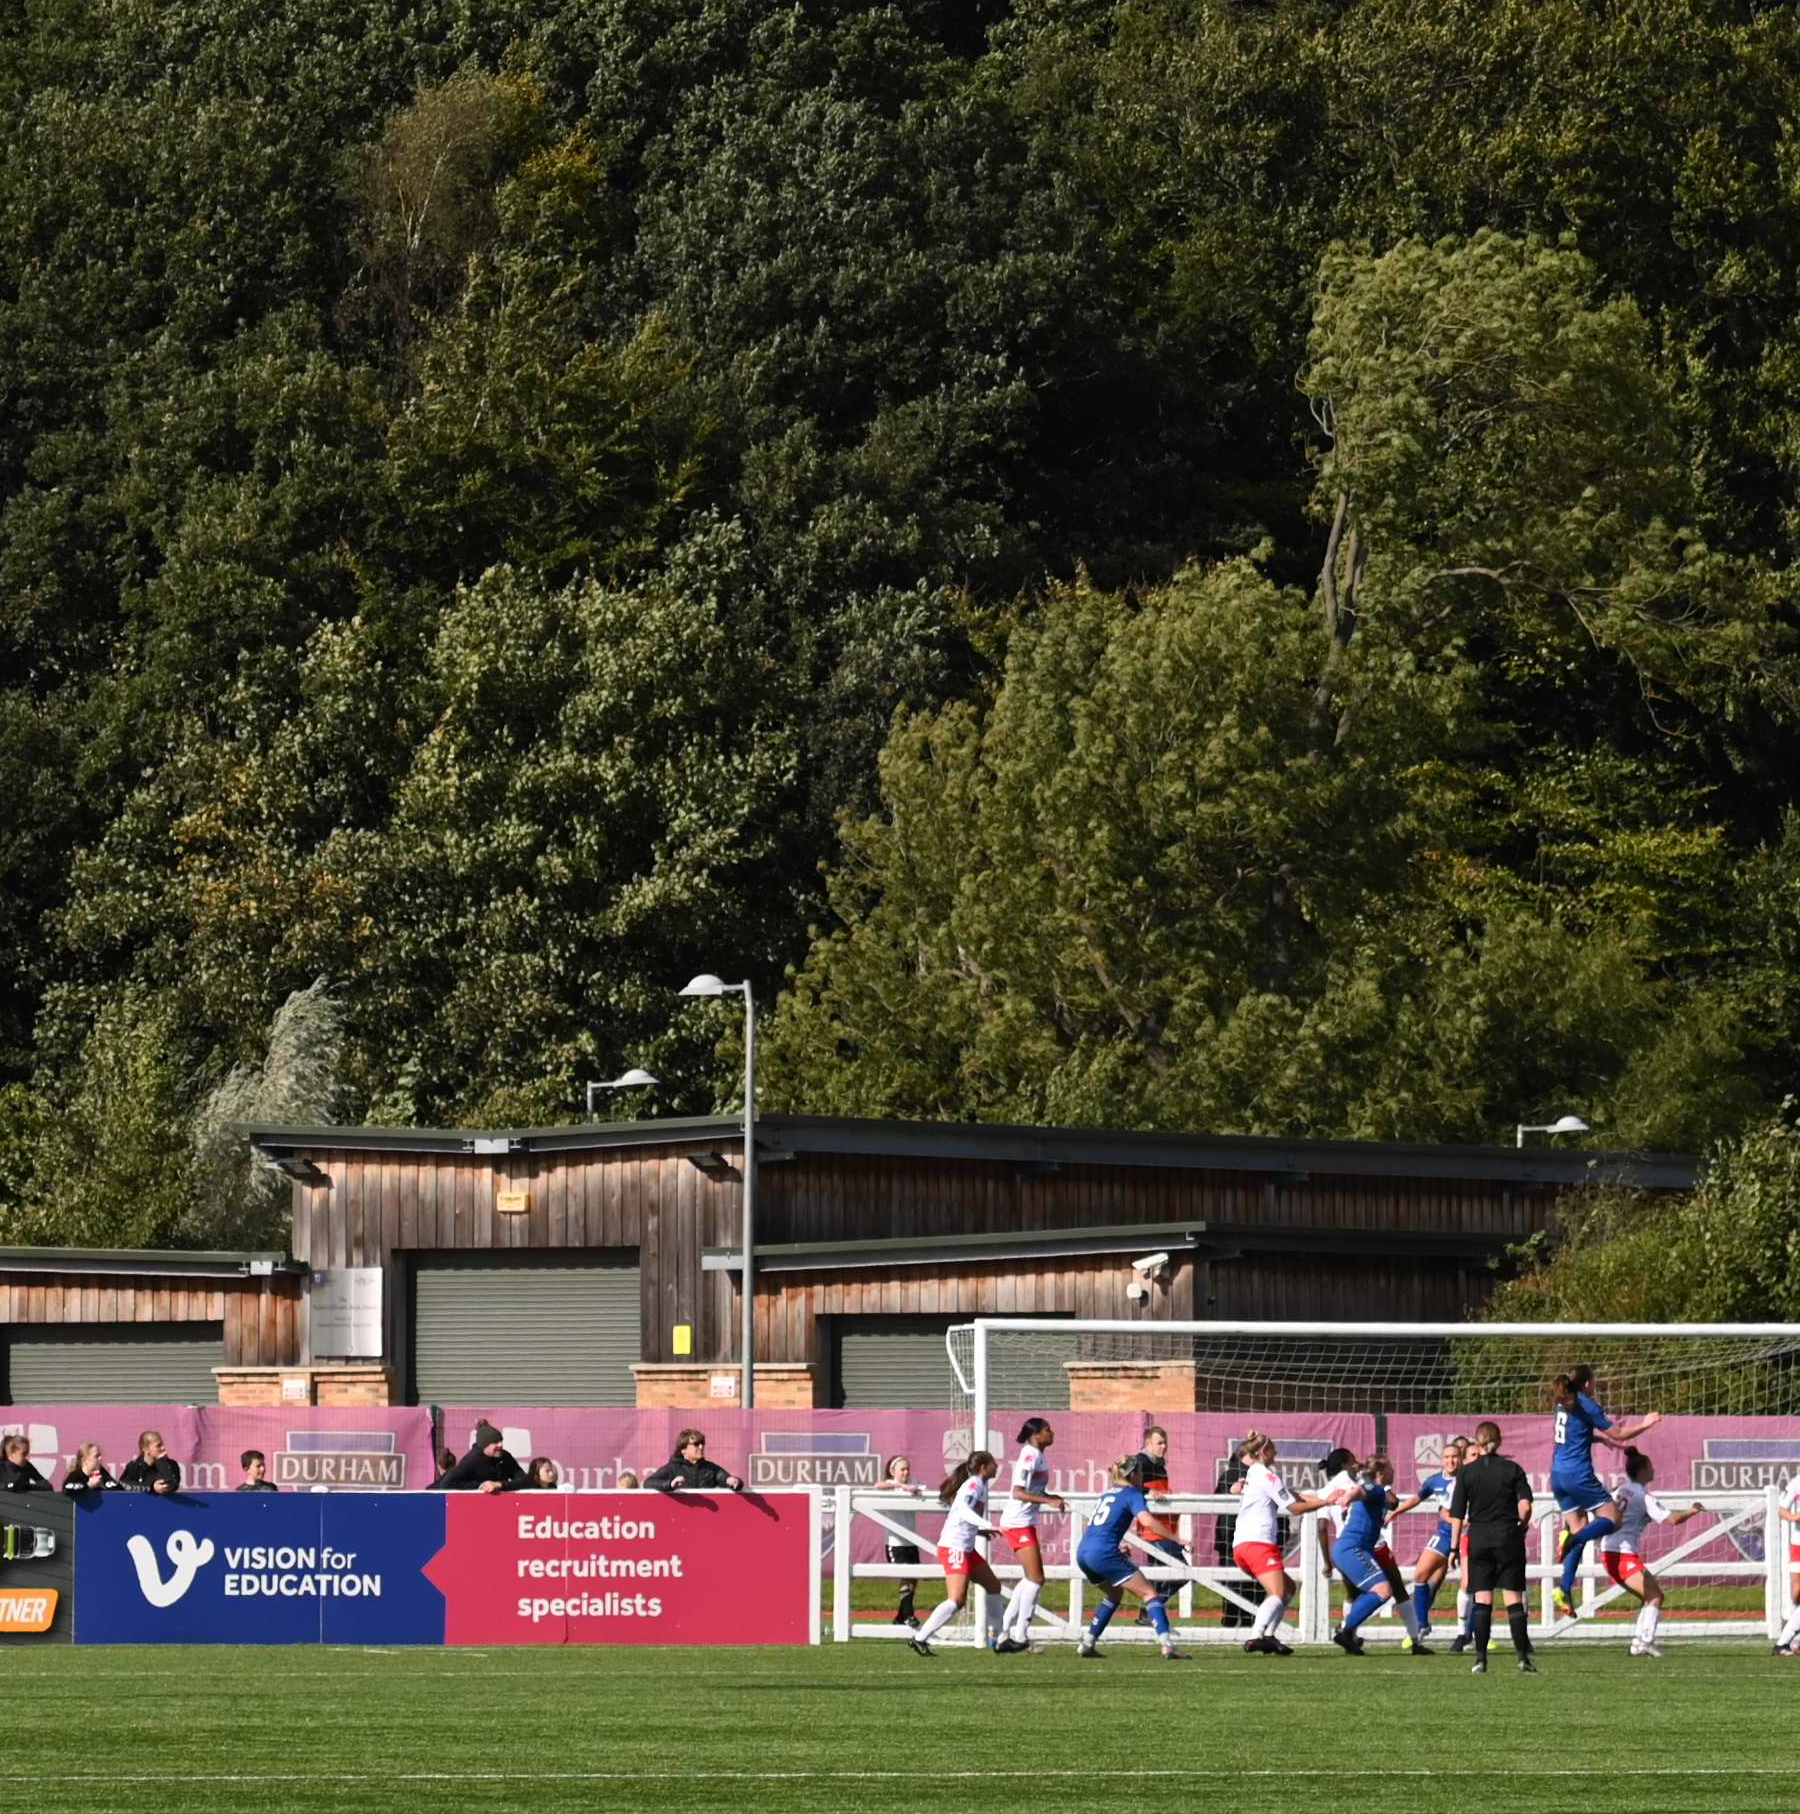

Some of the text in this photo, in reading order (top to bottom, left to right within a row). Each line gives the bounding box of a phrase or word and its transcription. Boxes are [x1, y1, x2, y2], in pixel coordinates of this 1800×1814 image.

[282, 1458, 397, 1482] DURHAM
[756, 1459, 874, 1484] DURHAM
[1700, 1464, 1800, 1488] DURHA
[517, 1515, 656, 1539] Education
[223, 1547, 356, 1570] VISION for
[517, 1554, 683, 1578] recruitment
[947, 1549, 964, 1564] 20
[224, 1574, 382, 1597] EDUCATION
[517, 1592, 663, 1623] specialists
